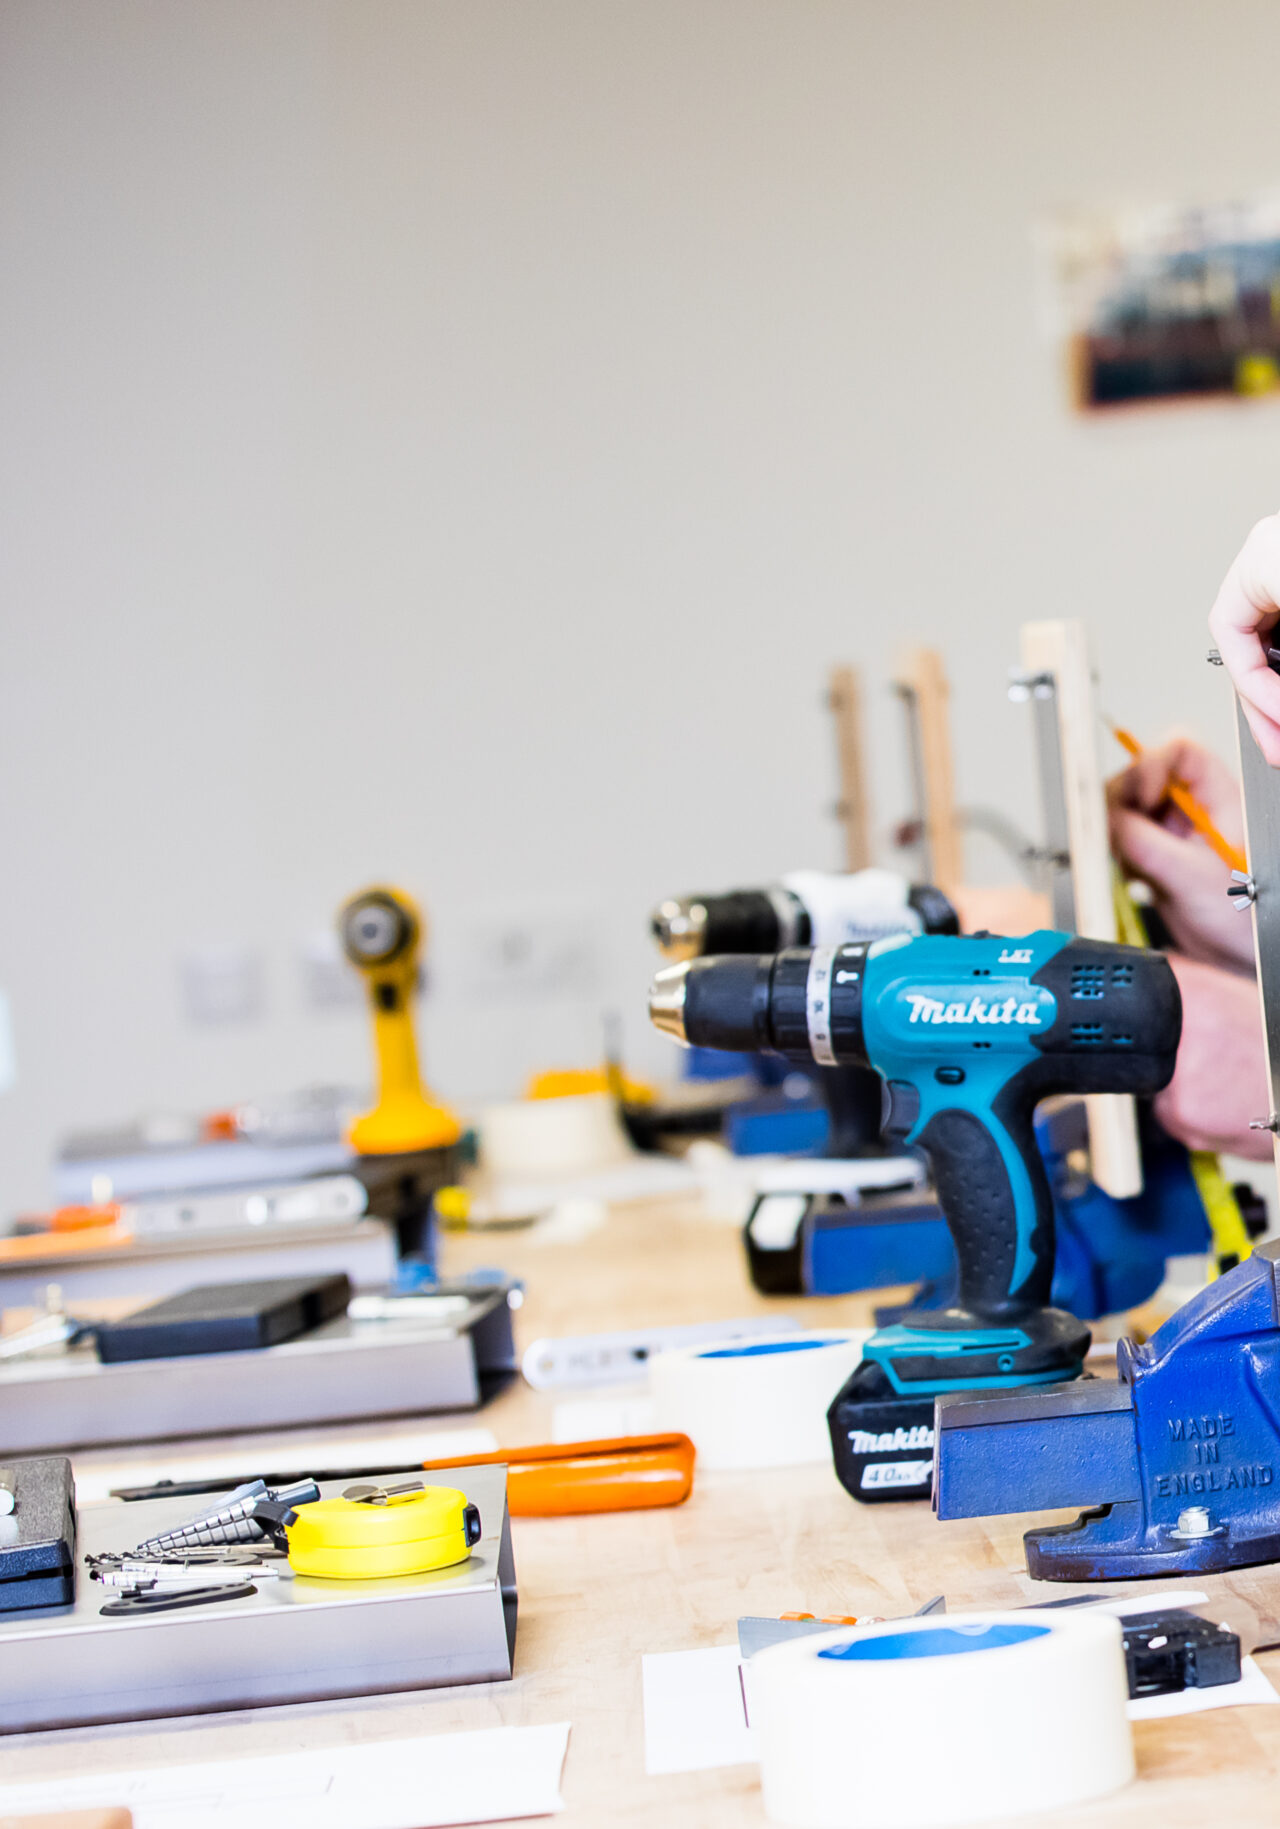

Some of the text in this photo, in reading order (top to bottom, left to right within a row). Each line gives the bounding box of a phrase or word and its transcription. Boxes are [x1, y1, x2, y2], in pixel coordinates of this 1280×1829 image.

[1168, 1413, 1236, 1442] MADE
[1193, 1442, 1220, 1466] IN
[1157, 1466, 1275, 1498] ENGLAND
